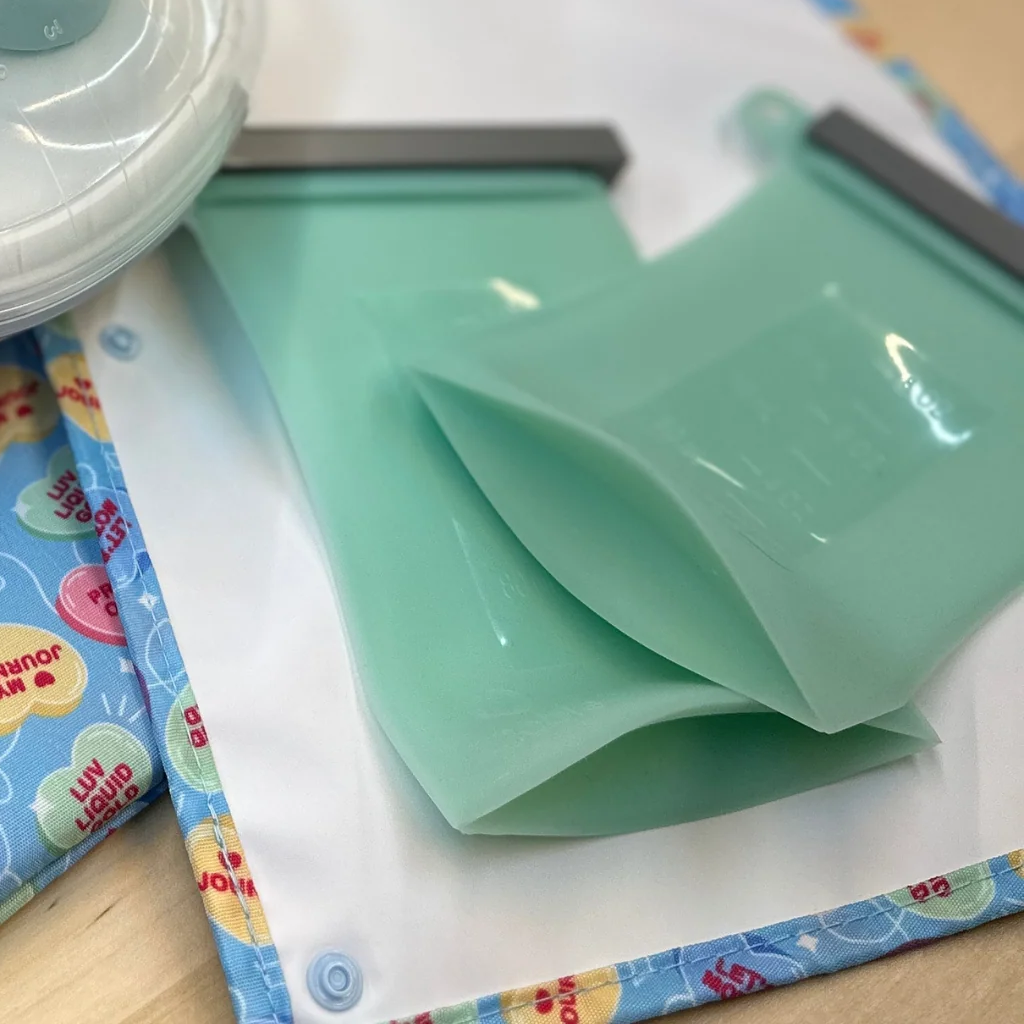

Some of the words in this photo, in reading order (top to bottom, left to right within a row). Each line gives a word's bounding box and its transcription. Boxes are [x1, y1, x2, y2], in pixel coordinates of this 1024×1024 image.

[47, 469, 77, 501] LUV
[69, 758, 105, 804] LUV
[74, 762, 134, 833] LIQUID
